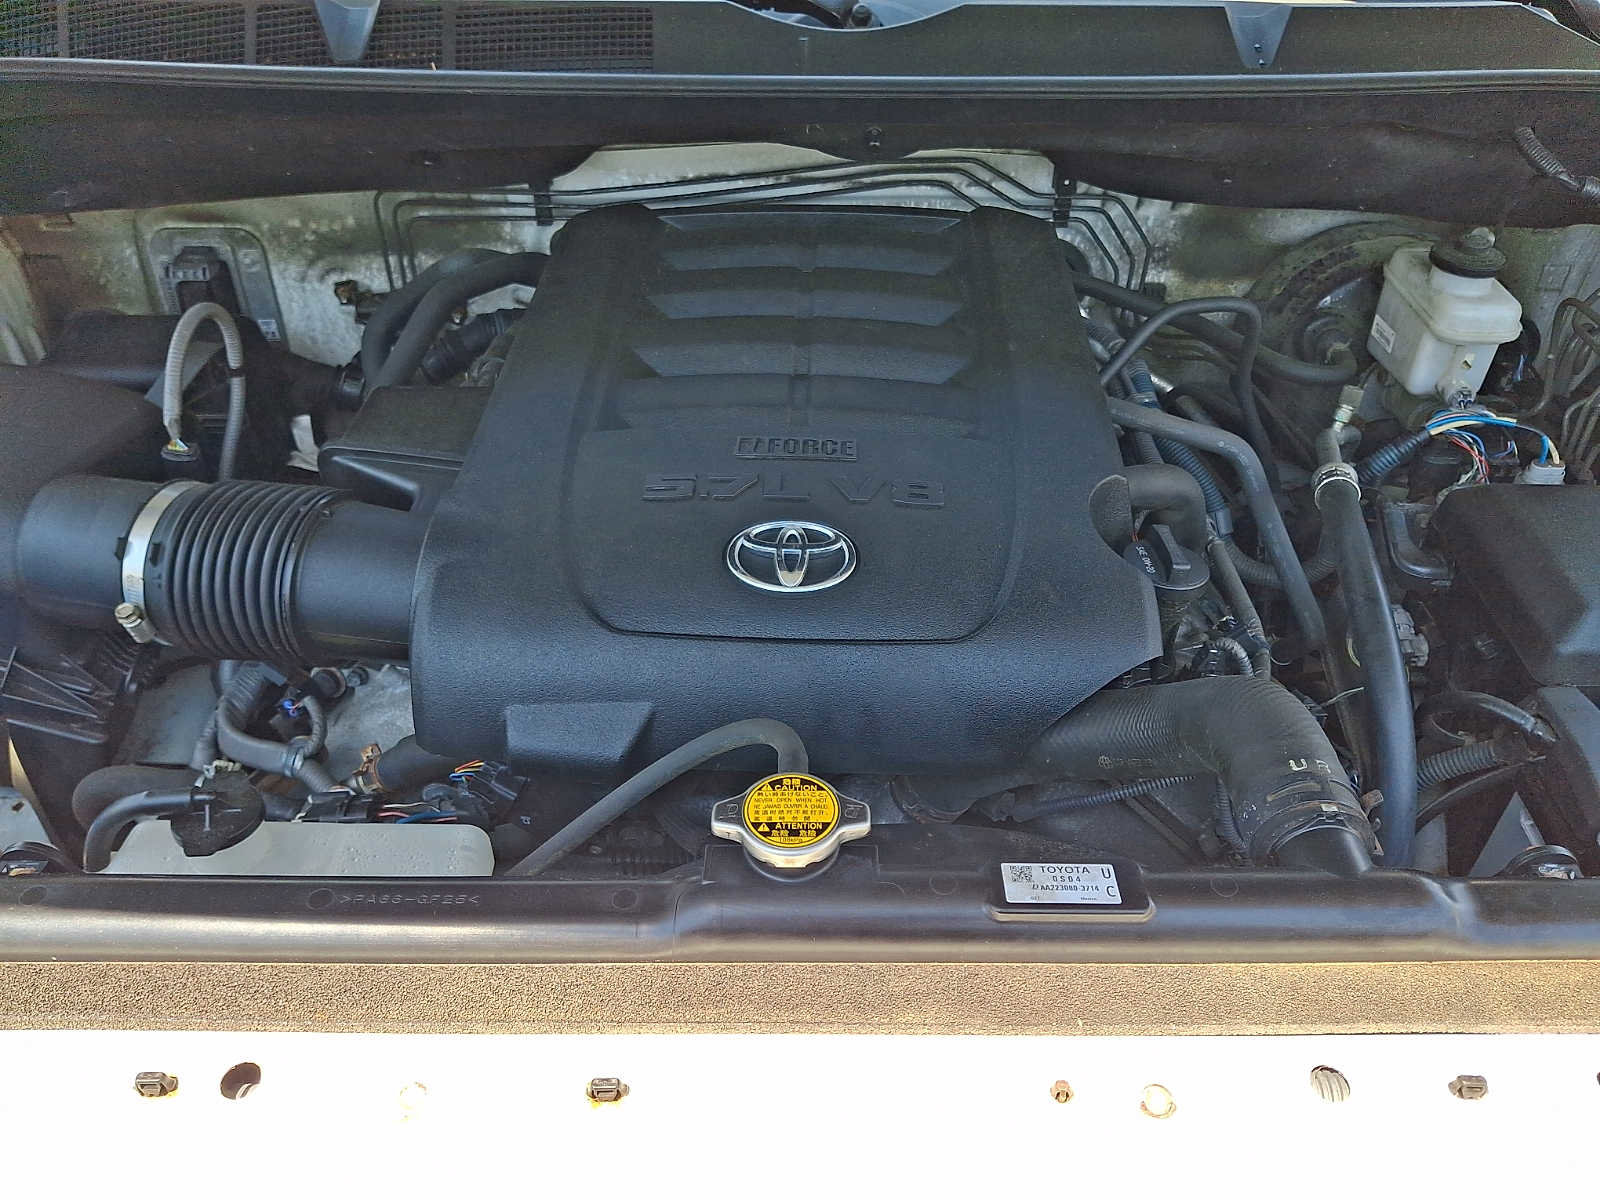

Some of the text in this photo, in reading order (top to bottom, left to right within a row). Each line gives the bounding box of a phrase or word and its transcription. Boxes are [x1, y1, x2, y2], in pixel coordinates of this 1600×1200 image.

[641, 472, 945, 507] 5.7L V8
[1040, 866, 1090, 874] TOYOTA
[1101, 868, 1111, 879] U
[1106, 885, 1117, 897] C
